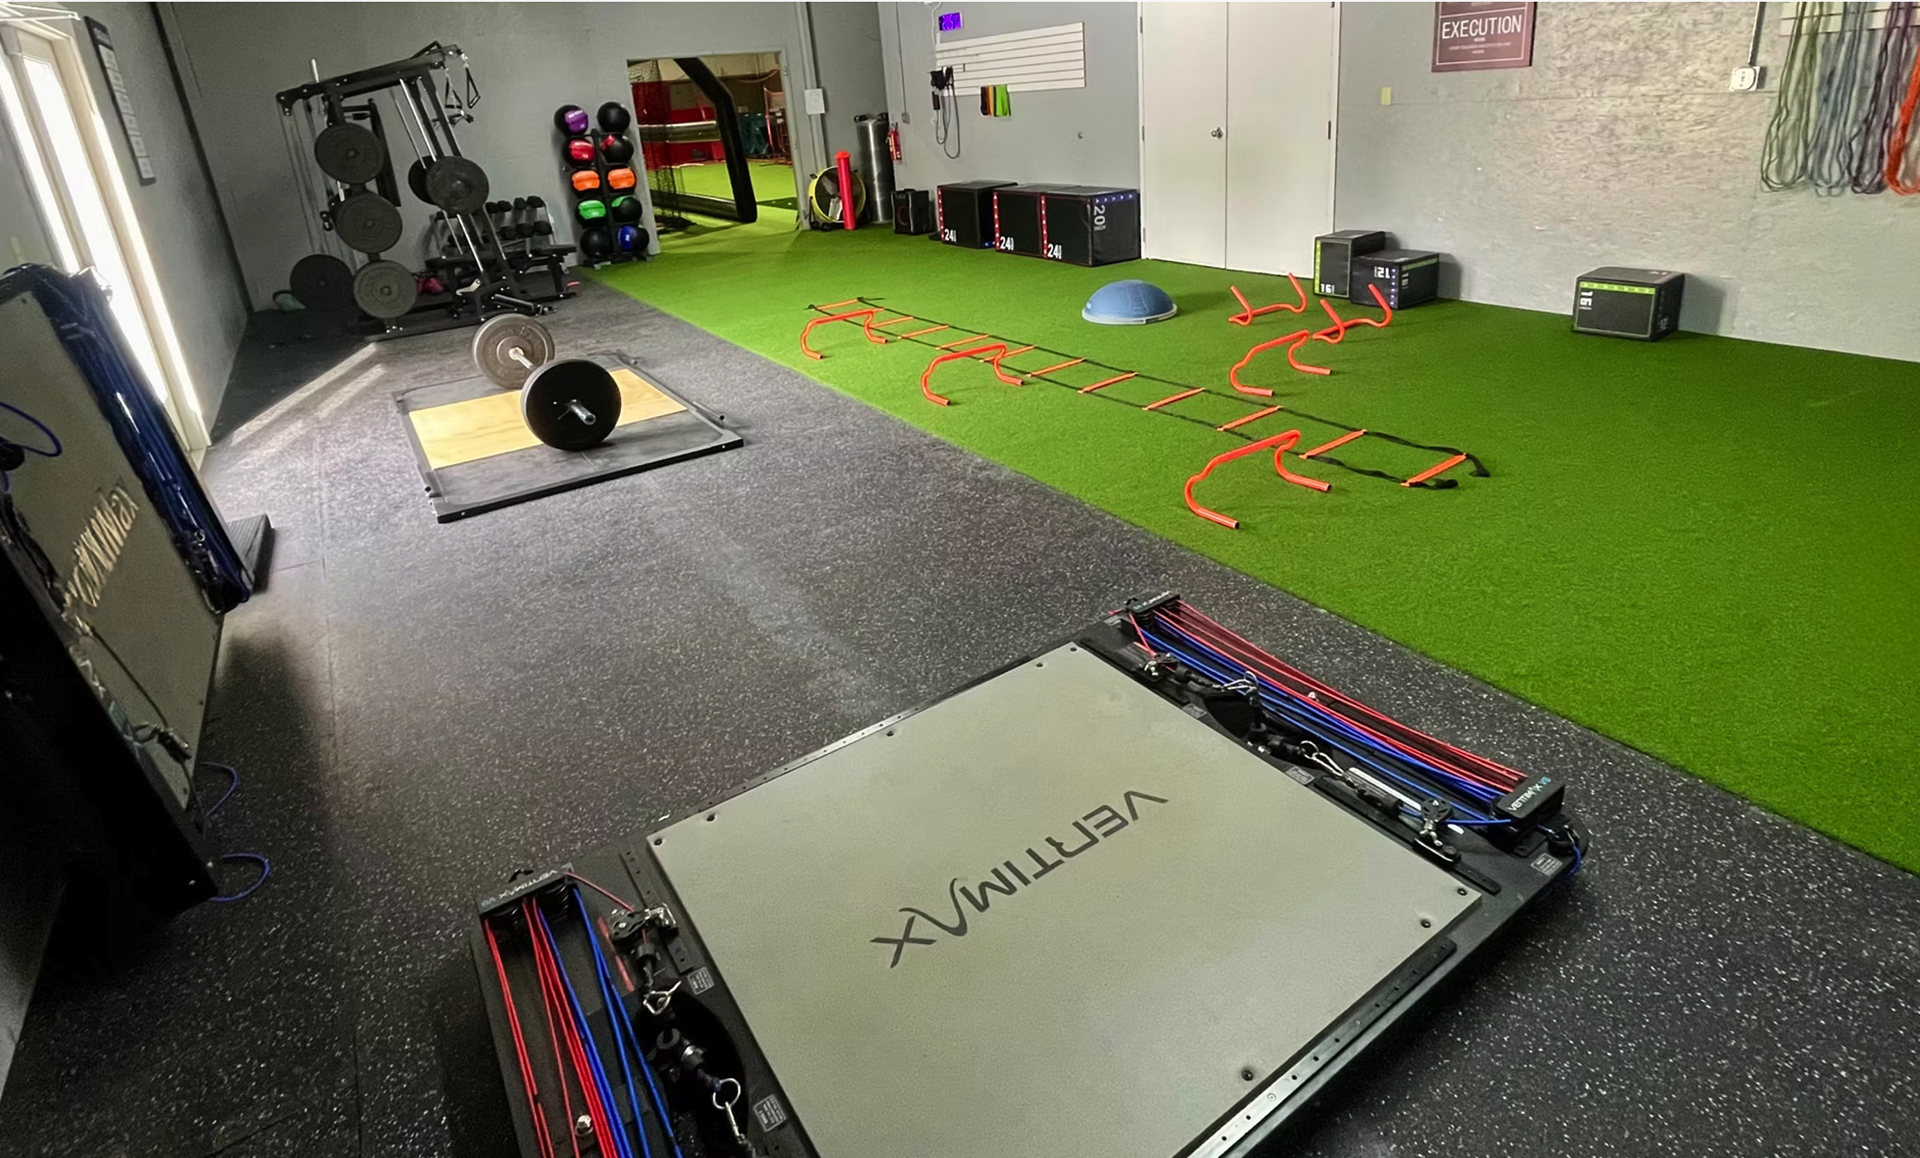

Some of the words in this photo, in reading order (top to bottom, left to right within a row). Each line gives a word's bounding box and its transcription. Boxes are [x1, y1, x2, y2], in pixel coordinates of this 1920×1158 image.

[1442, 14, 1522, 39] EXECUTION
[1093, 204, 1106, 226] 20
[944, 228, 953, 242] 24
[999, 236, 1010, 250] 24
[1047, 243, 1058, 258] 24
[1377, 266, 1390, 279] 12
[1320, 283, 1332, 293] 16
[1579, 291, 1593, 306] 16
[869, 790, 1169, 969] VERTIMAX
